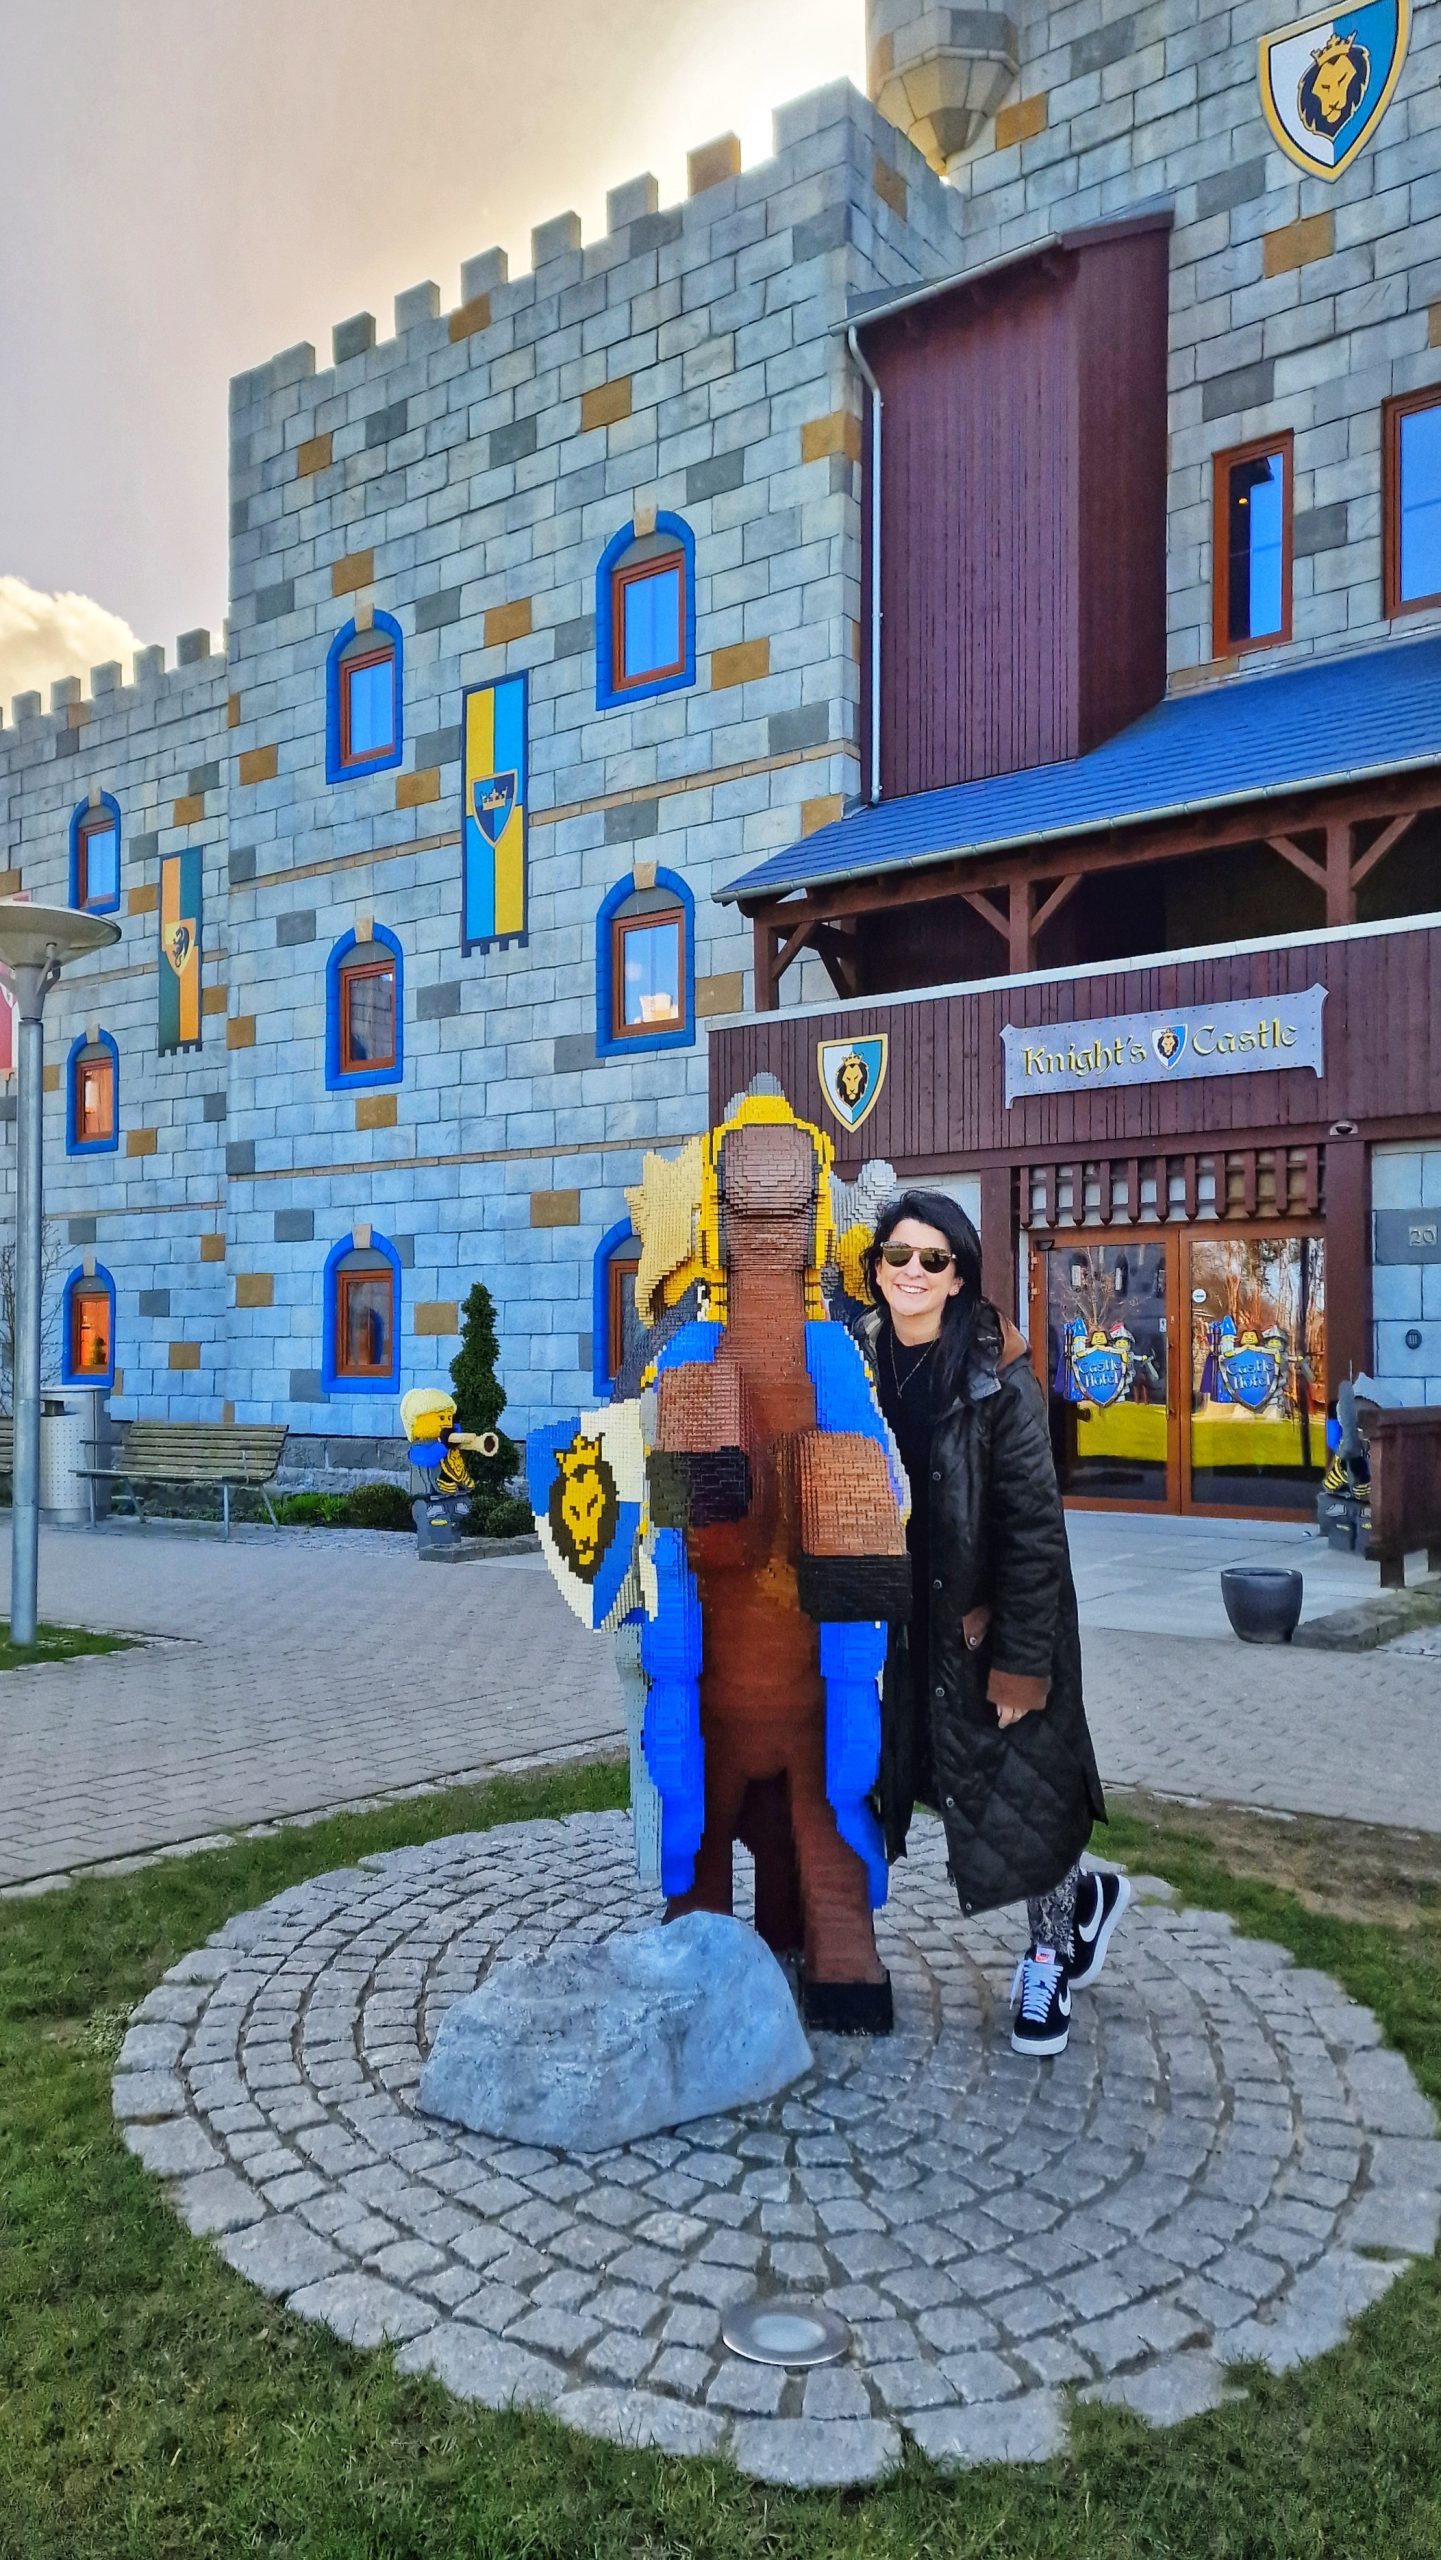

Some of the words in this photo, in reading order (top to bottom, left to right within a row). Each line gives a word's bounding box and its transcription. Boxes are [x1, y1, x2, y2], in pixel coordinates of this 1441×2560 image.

[1022, 1034, 1148, 1077] Knight's
[1191, 1017, 1298, 1056] Castle
[1410, 1228, 1435, 1245] 20
[1078, 1357, 1121, 1374] Castle
[1226, 1358, 1273, 1376] Castle
[1083, 1370, 1119, 1388] Hotel
[1232, 1373, 1270, 1390] Hotel
